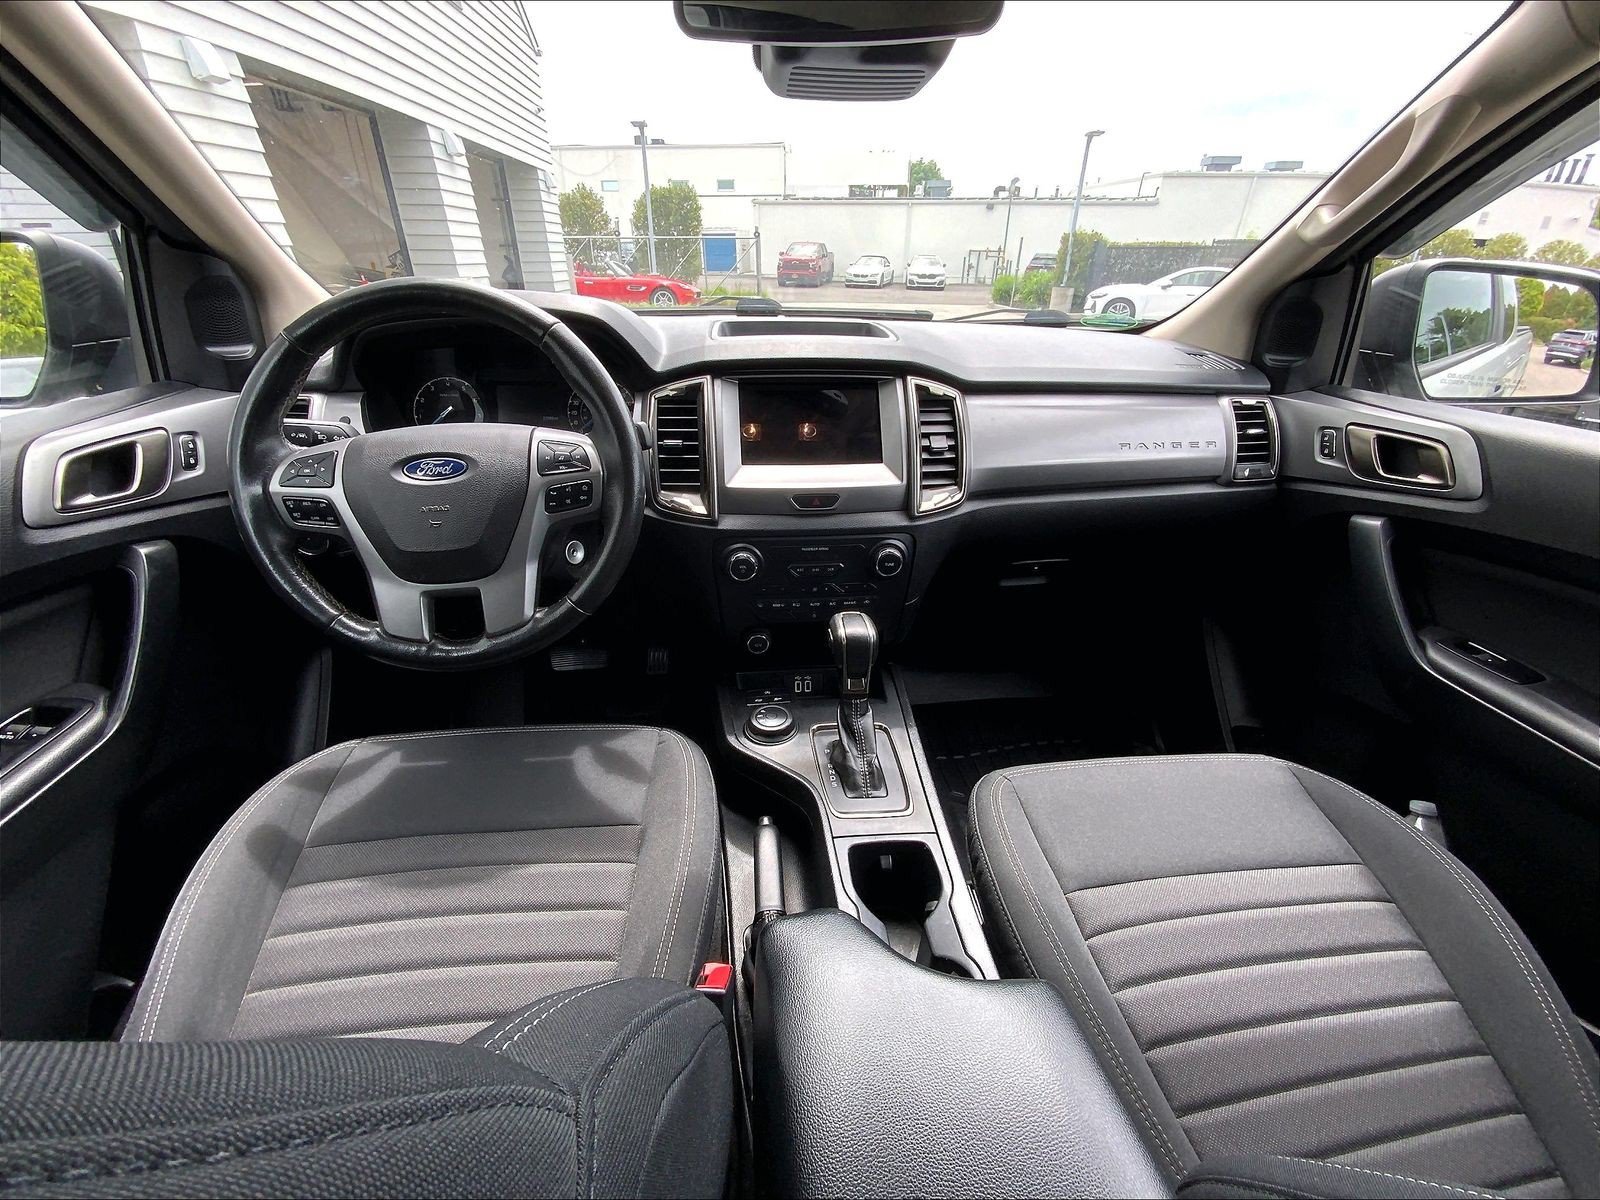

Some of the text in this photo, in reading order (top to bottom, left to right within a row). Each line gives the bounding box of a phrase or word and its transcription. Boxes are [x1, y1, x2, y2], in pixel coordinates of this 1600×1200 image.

[1118, 440, 1217, 450] RANGER
[416, 460, 454, 476] Ford
[419, 504, 450, 512] AIRBAG
